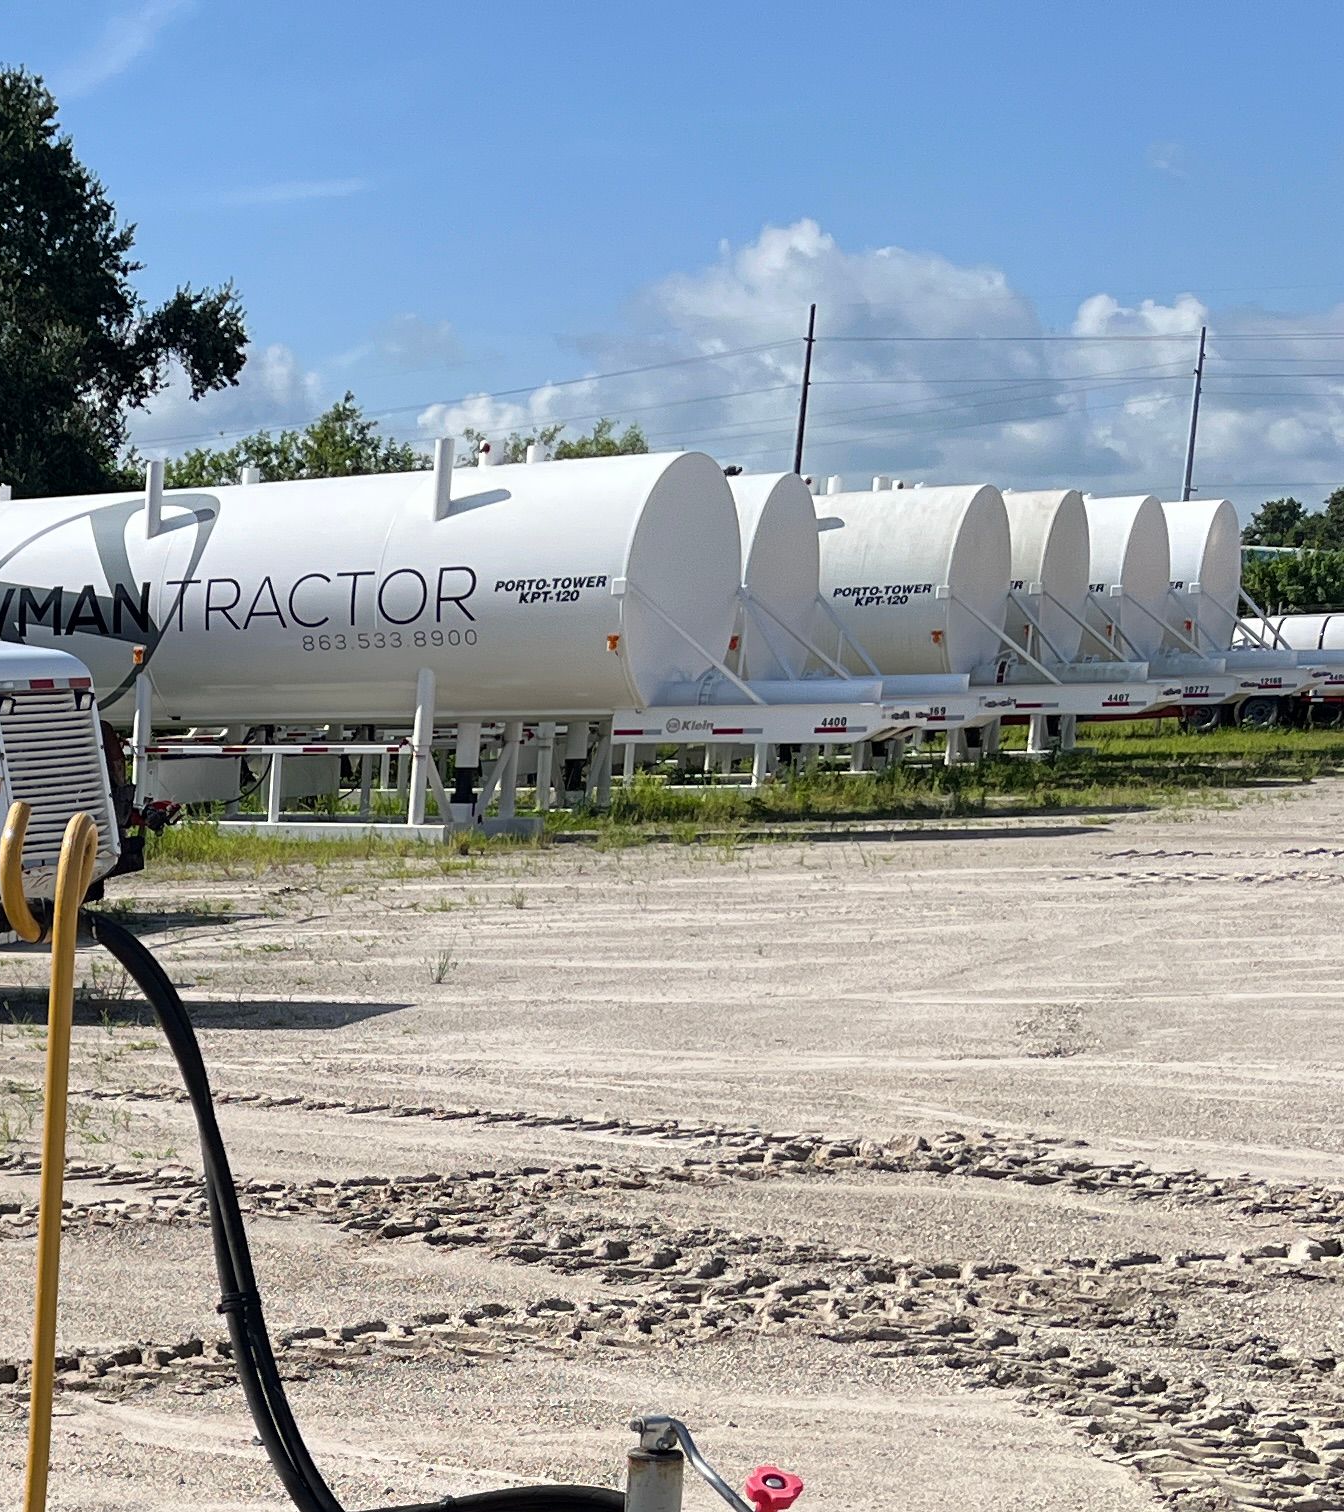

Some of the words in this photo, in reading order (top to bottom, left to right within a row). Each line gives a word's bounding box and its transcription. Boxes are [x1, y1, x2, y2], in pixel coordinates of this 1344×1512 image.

[494, 575, 608, 592] PORTO-TOWER
[833, 583, 933, 598] PORTO-TOWER
[518, 590, 580, 604] KPT-120
[854, 595, 909, 606] KPT-120
[302, 629, 478, 651] 863.533.8900
[681, 719, 714, 731] Klein
[821, 717, 847, 728] 4400
